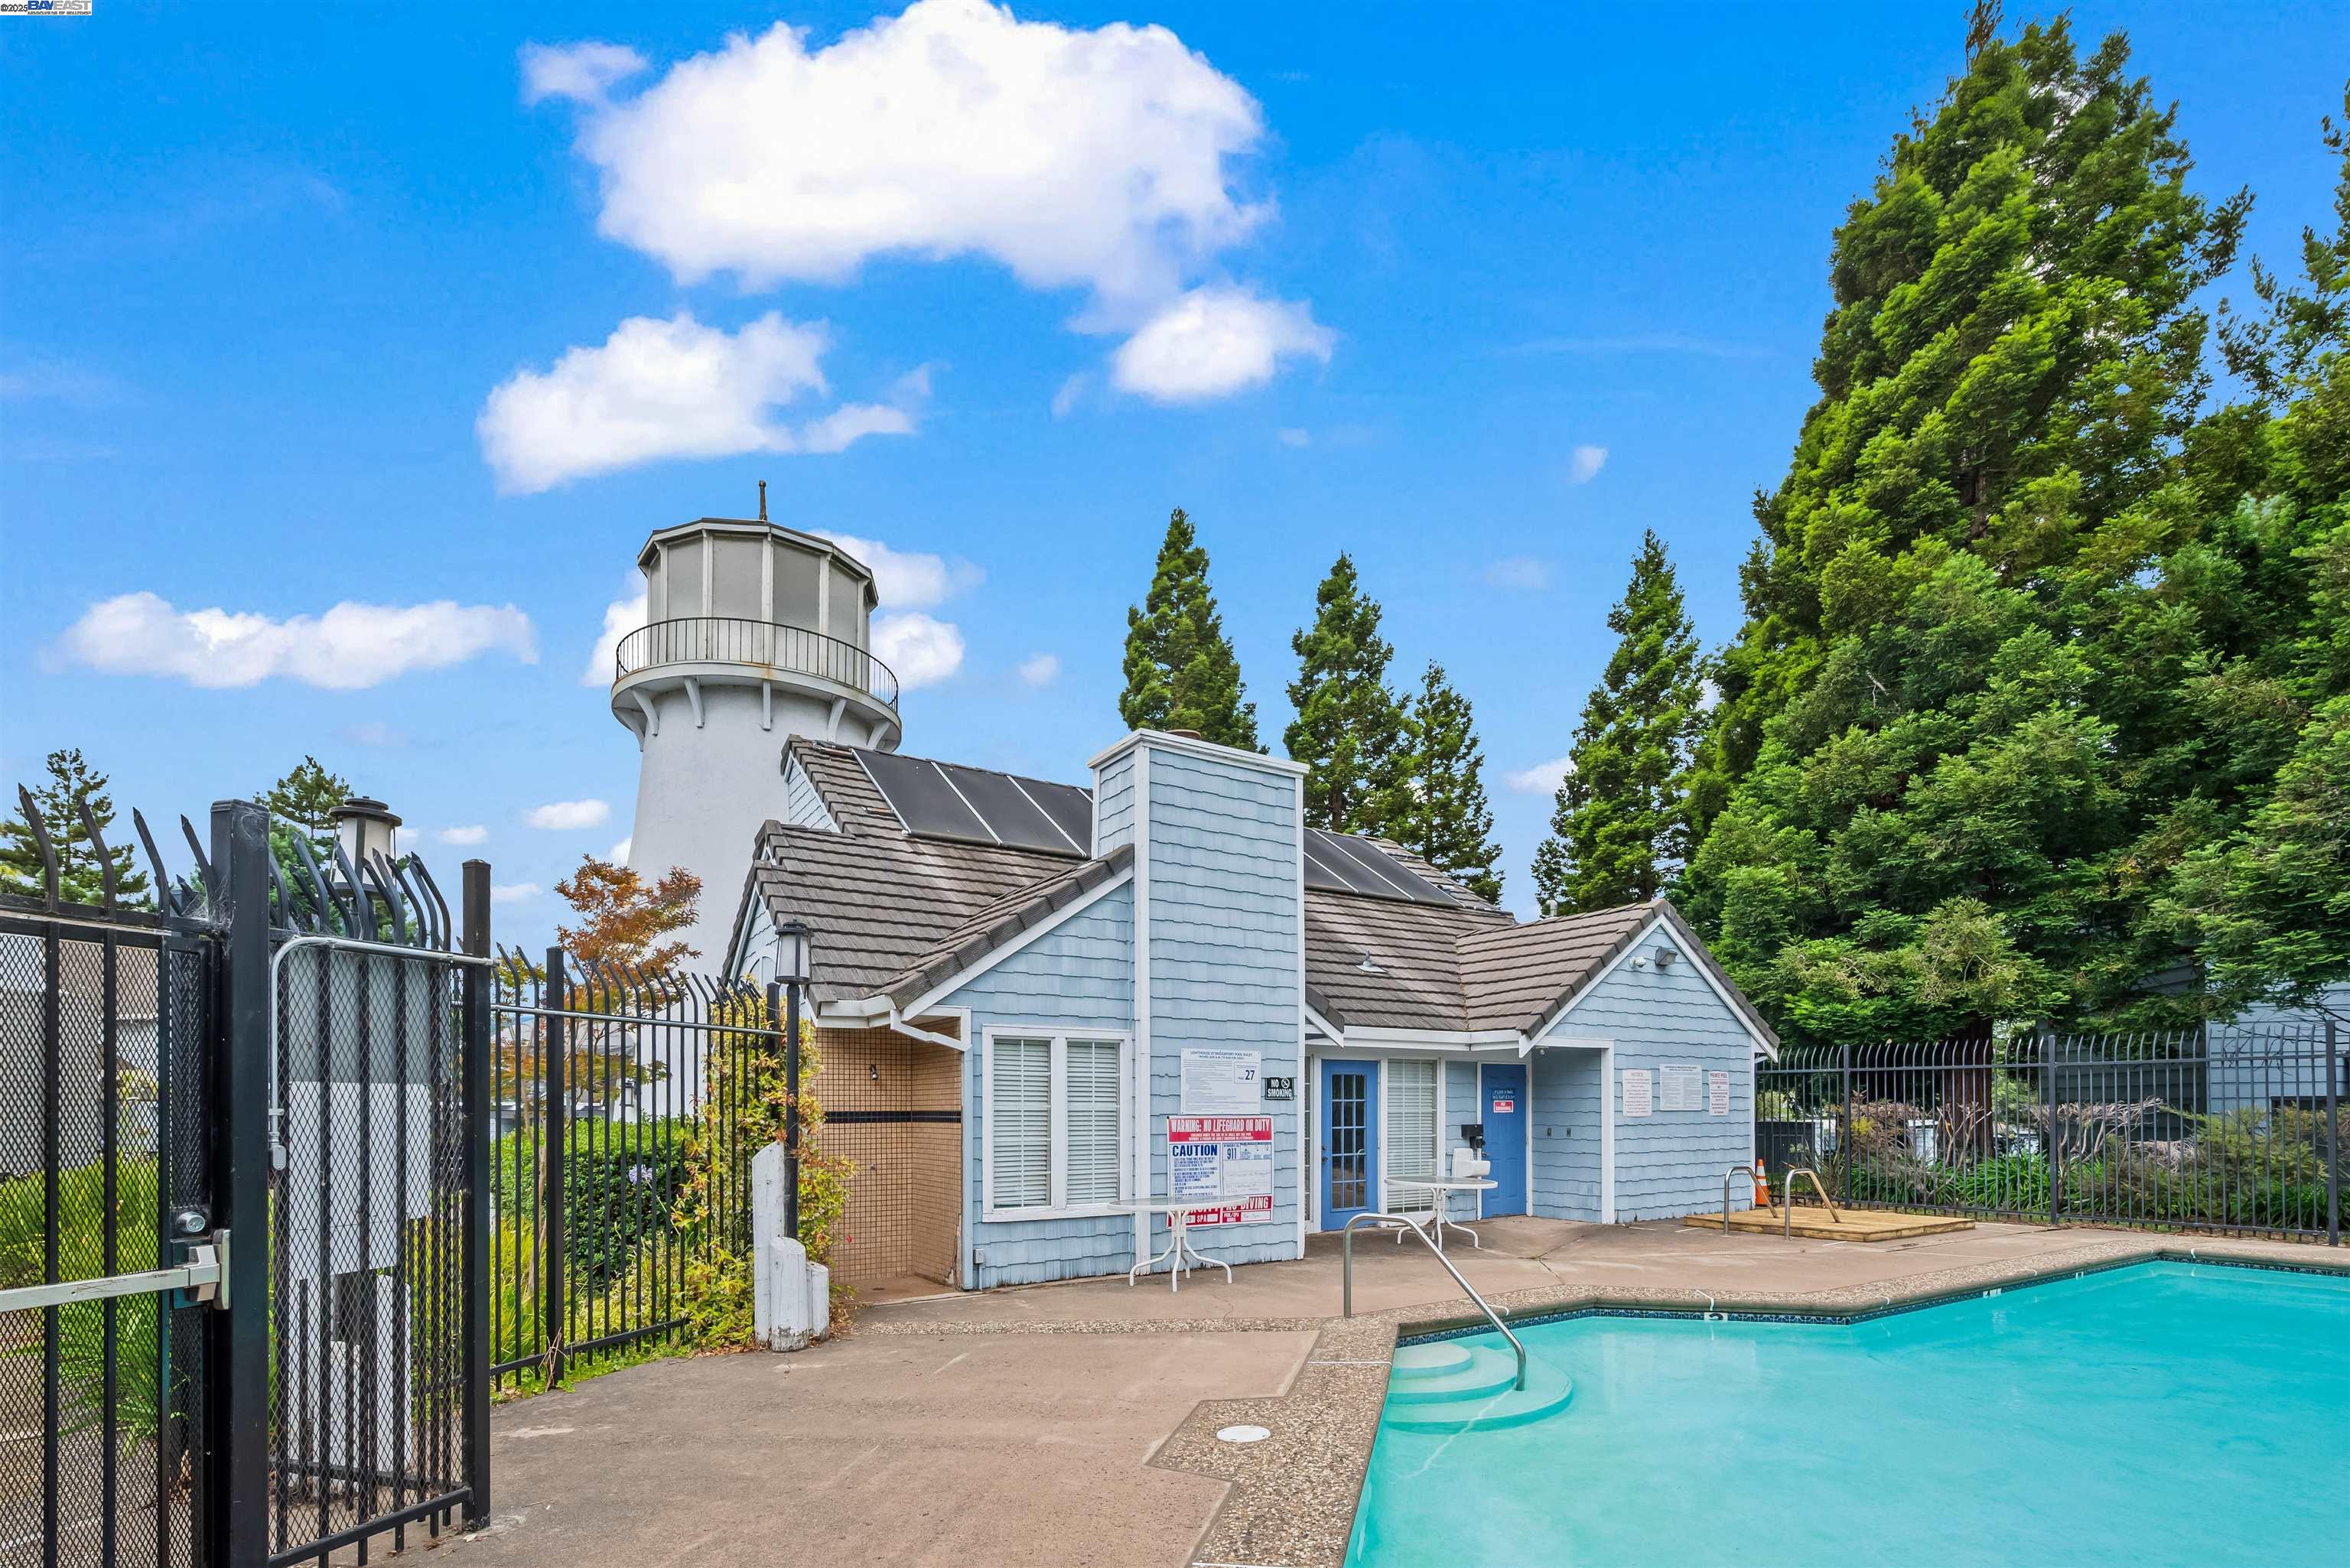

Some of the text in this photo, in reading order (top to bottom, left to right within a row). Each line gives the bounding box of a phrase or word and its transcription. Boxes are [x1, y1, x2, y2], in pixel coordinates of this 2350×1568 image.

[1245, 1069, 1255, 1080] 27
[1271, 1078, 1279, 1088] NO
[1268, 1088, 1292, 1097] SMOKING
[1170, 1118, 1270, 1132] WARNING: NO LIFEGUARD ON DUTY
[1172, 1144, 1218, 1156] CAUTION
[1227, 1147, 1237, 1160] 911
[1196, 1214, 1207, 1223] SPA
